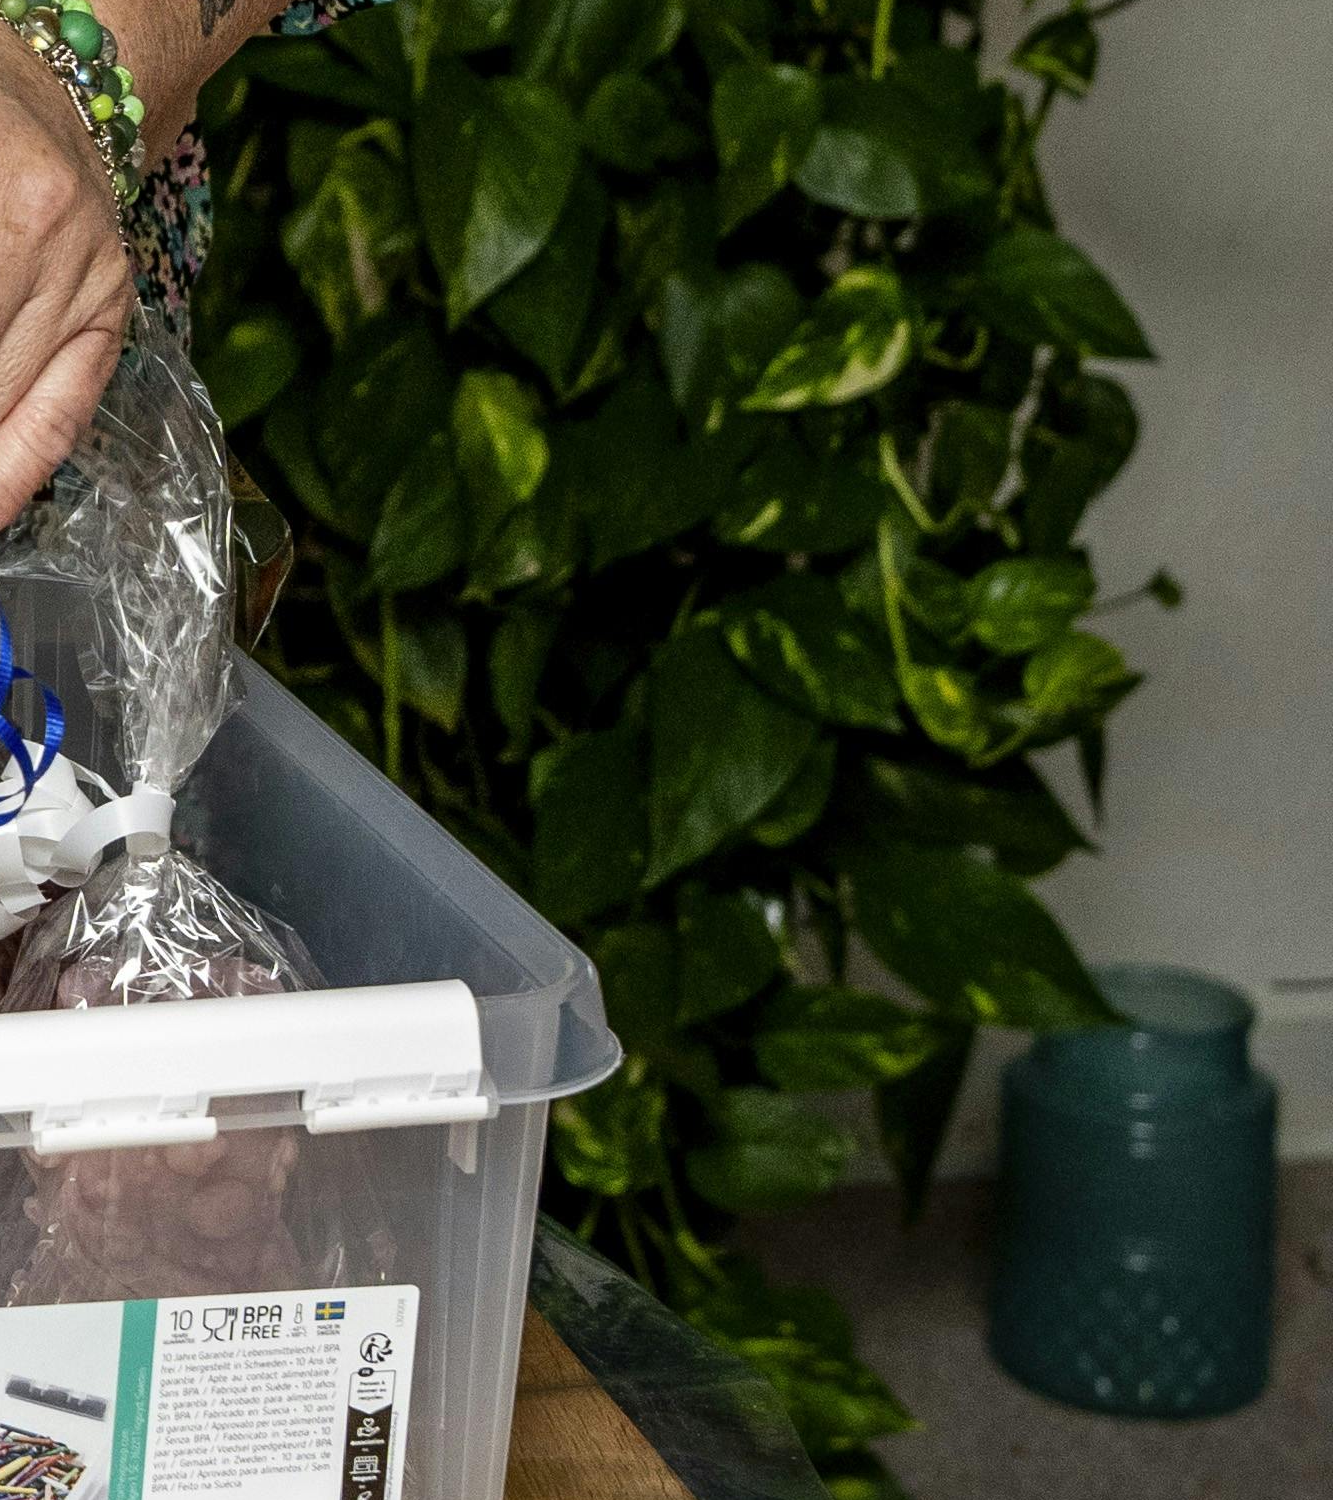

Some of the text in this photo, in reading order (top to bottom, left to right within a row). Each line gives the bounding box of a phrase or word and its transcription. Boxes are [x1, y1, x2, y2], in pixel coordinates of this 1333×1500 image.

[168, 1309, 193, 1331] 10
[242, 1304, 283, 1324] BPA
[240, 1324, 281, 1340] FREE
